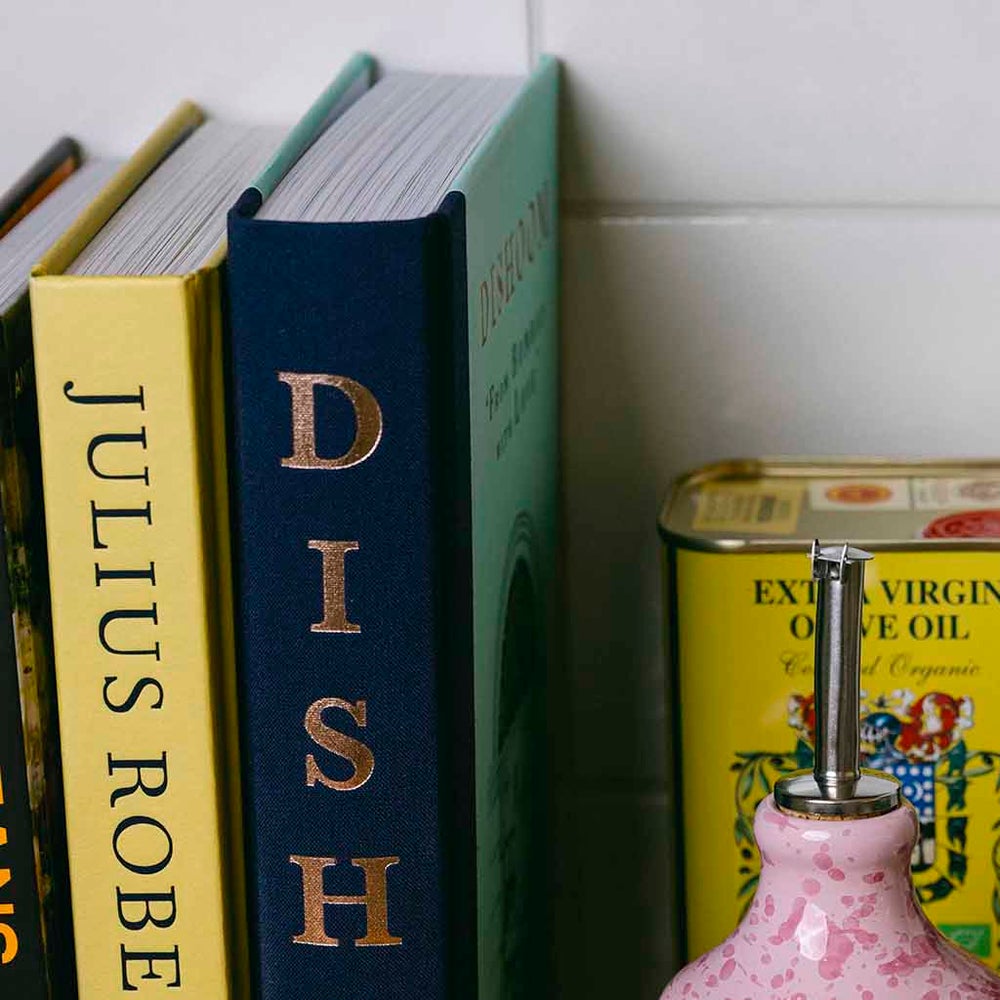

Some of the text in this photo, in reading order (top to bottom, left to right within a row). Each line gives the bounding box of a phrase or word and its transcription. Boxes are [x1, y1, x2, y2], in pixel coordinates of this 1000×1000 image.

[63, 380, 165, 714] JULIUS
[754, 579, 870, 605] EXT
[790, 614, 969, 640] OVE OIL
[888, 653, 981, 686] Organic
